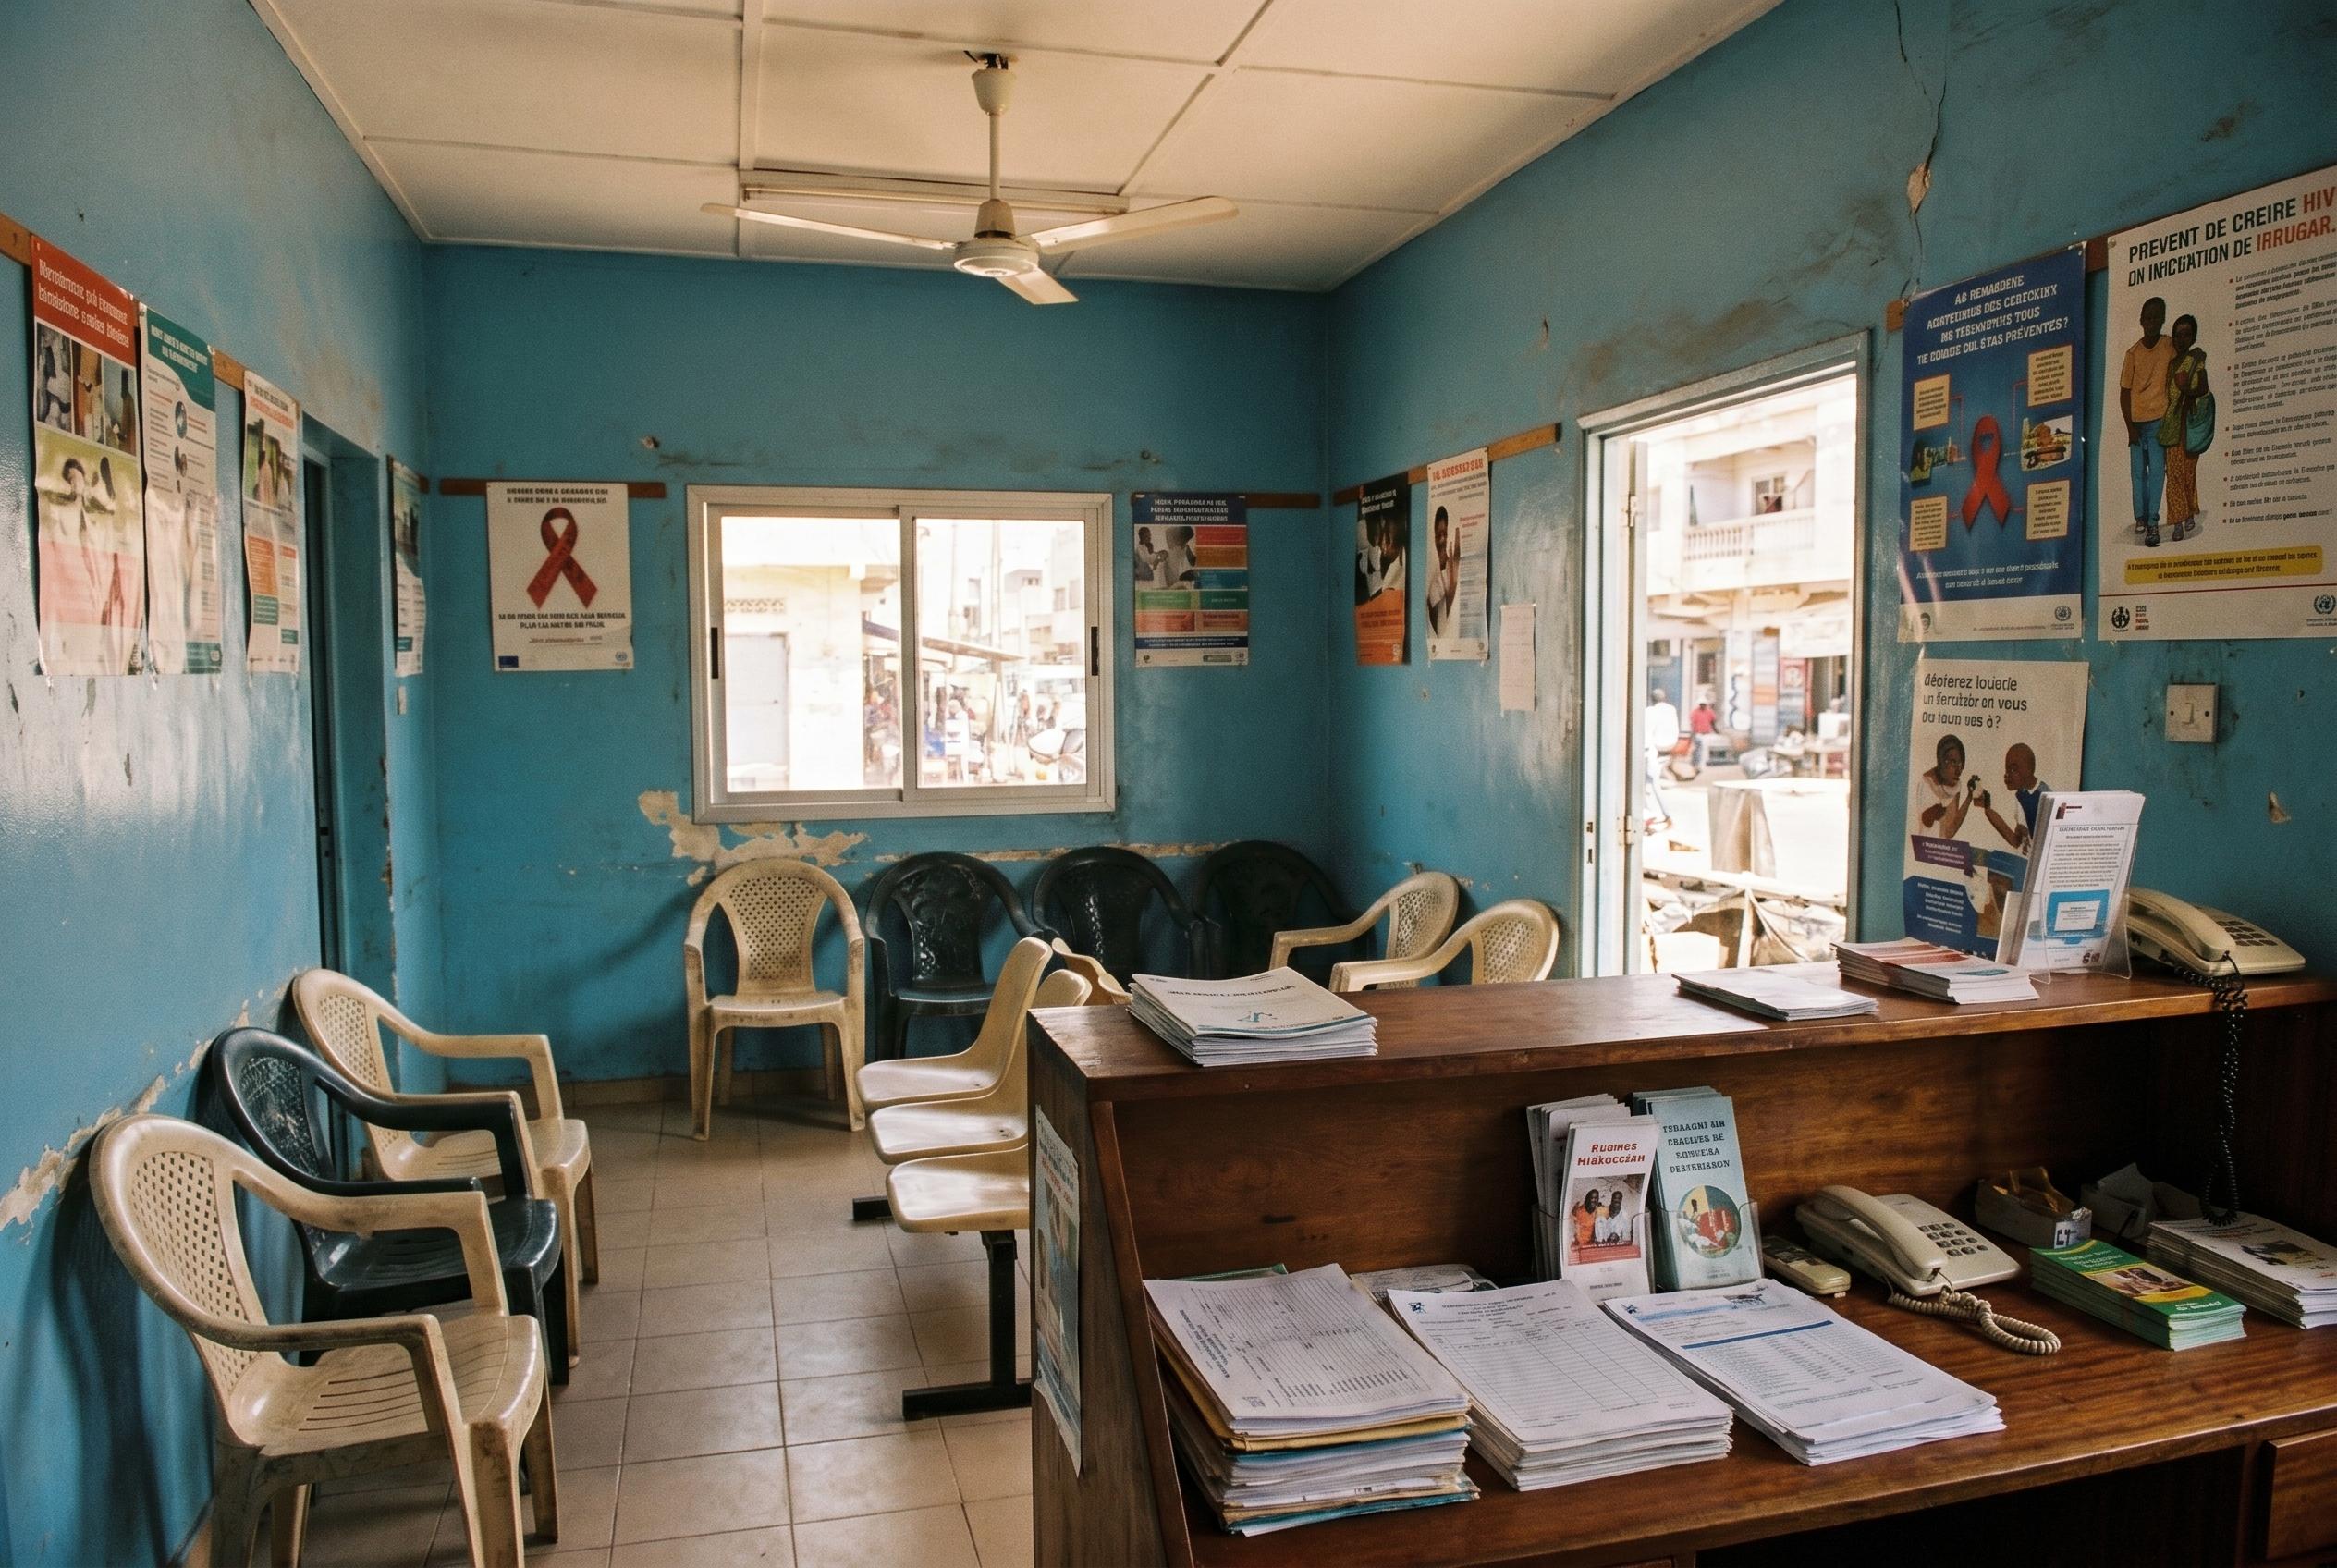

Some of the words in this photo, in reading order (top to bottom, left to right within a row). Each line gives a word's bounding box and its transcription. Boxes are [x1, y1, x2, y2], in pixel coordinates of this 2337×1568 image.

[2129, 227, 2199, 263] PREVENT
[2205, 218, 2226, 241] DE
[2233, 198, 2296, 230] CREIRE
[2303, 186, 2337, 214] HIV
[2233, 236, 2252, 258] DE
[2014, 306, 2040, 323] TOUS
